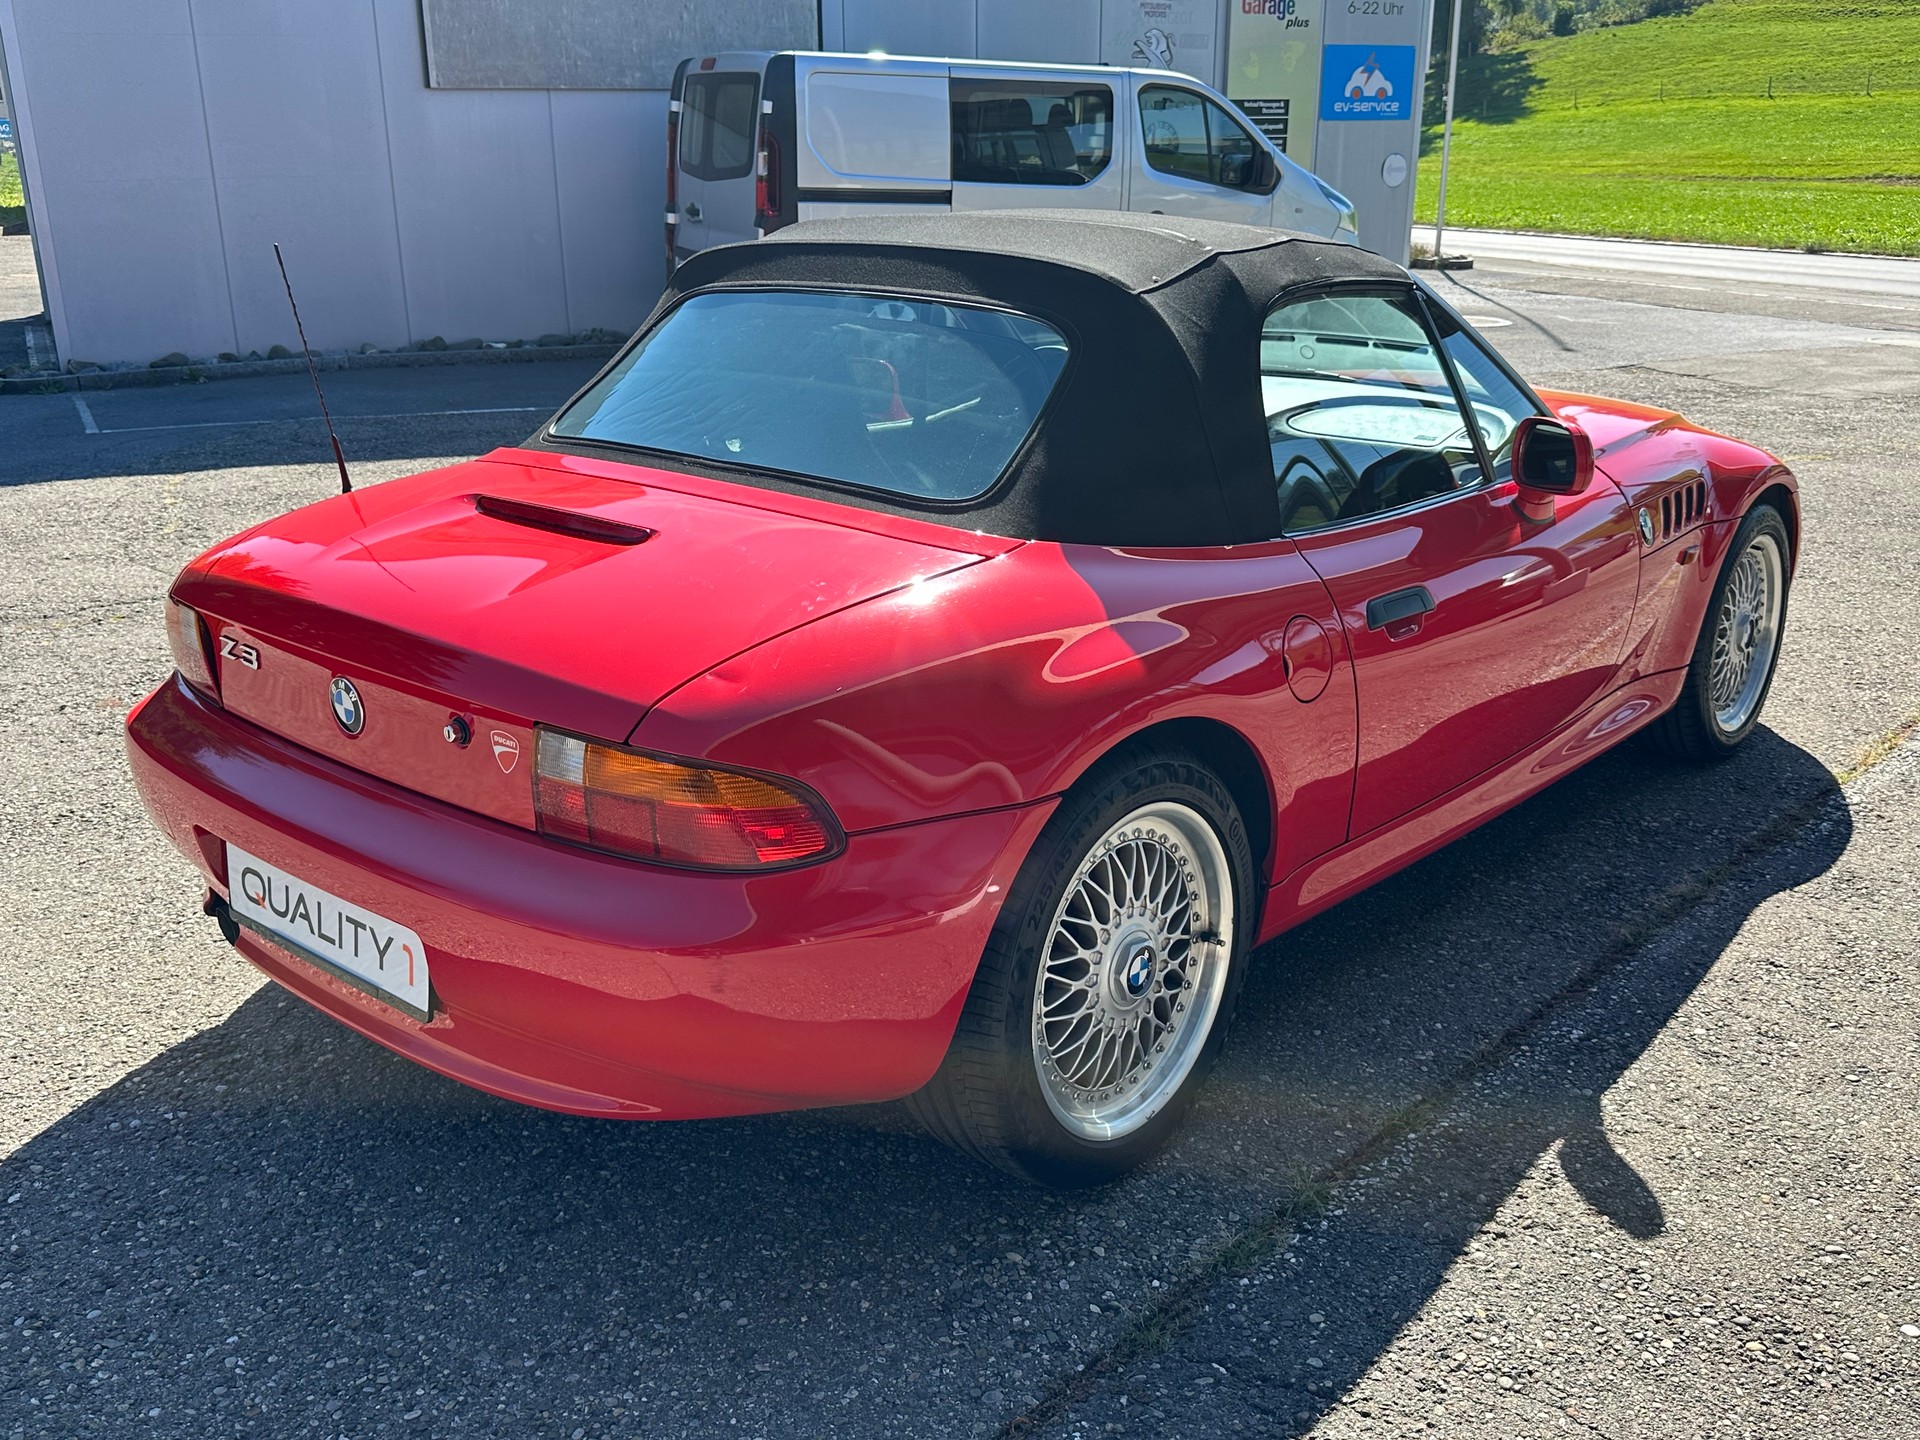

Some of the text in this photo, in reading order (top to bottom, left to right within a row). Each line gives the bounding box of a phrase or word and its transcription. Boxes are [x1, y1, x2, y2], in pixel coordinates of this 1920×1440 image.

[1242, 0, 1296, 20] Garage
[1347, 1, 1404, 15] 6-22 Uhr
[1285, 16, 1310, 29] plus
[1334, 101, 1400, 112] ev-service
[218, 635, 258, 671] Z3
[331, 680, 357, 702] BMW
[493, 734, 517, 749] DUCATI
